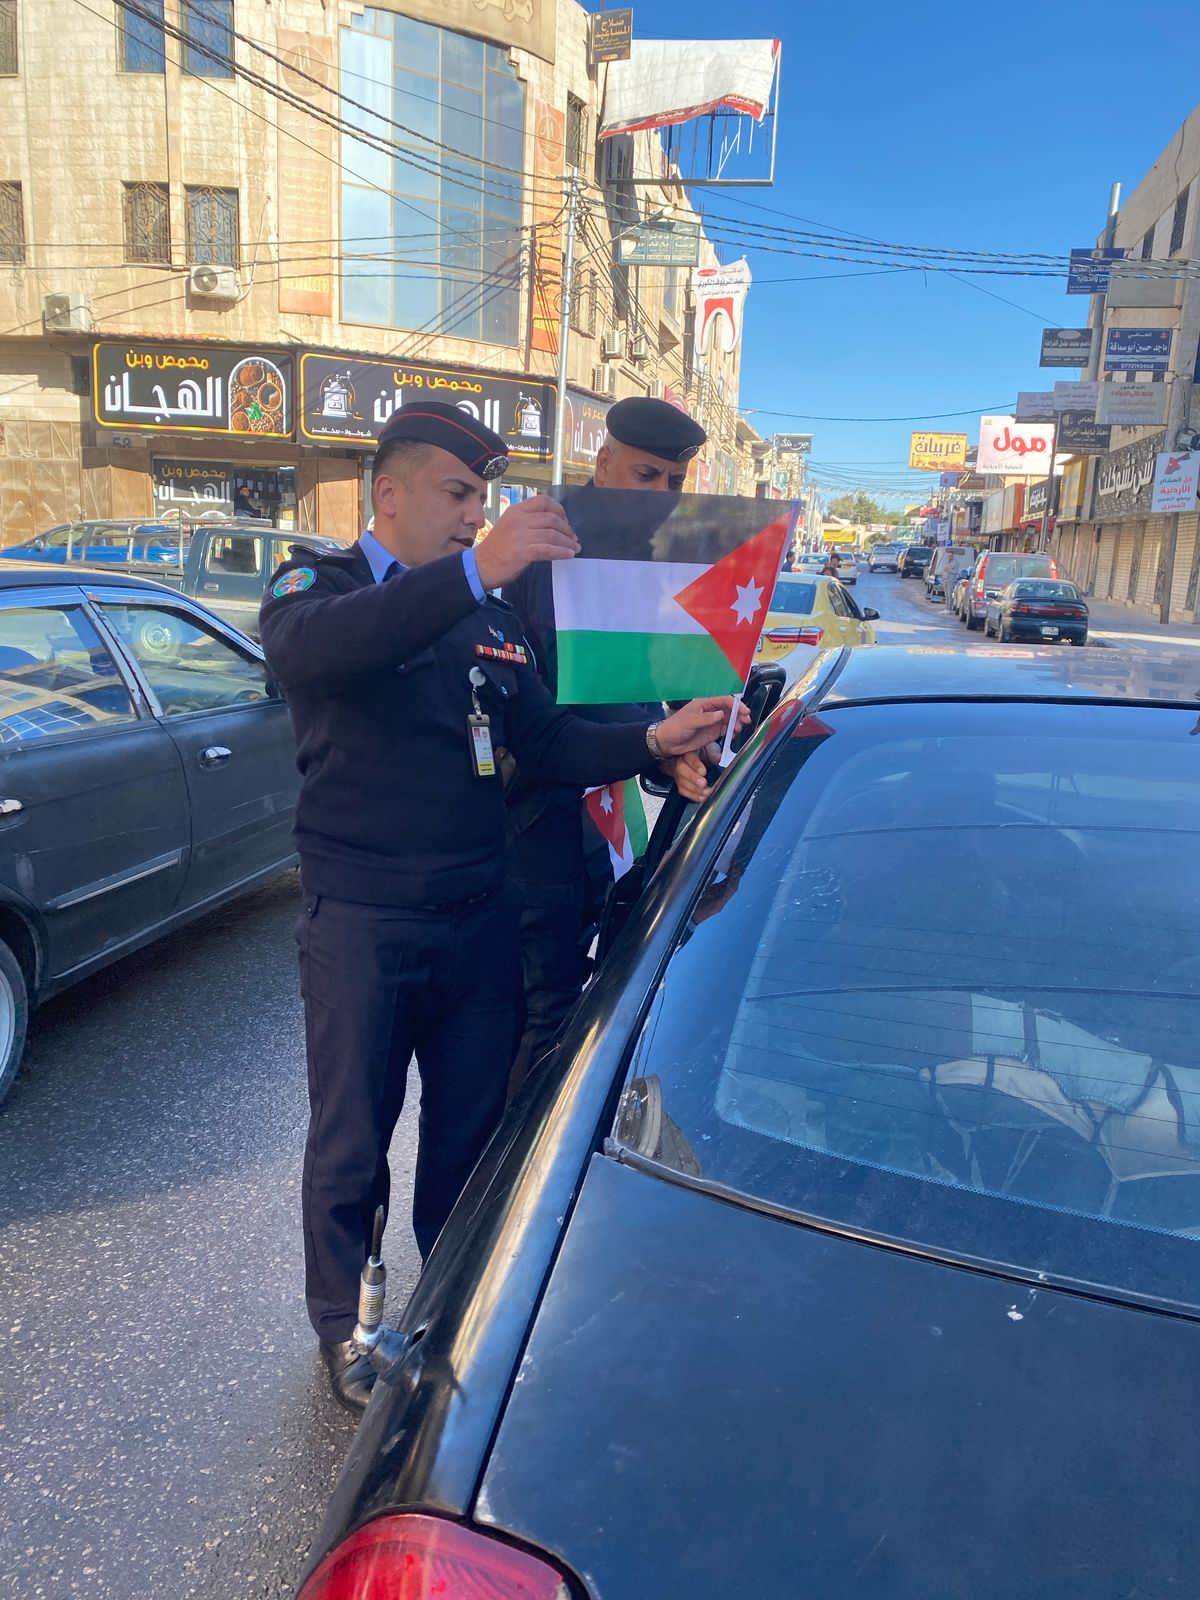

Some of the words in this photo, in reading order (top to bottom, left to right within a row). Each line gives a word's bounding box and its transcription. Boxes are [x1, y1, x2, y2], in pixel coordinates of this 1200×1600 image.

[125, 350, 153, 369] وبن
[156, 355, 209, 370] محمص
[393, 369, 423, 389] وبن
[426, 373, 484, 394] محمص
[104, 371, 222, 423] الهجان
[993, 426, 1046, 456] مول
[161, 465, 183, 477] وبن
[184, 467, 226, 479] محمص
[158, 479, 231, 506] الهجان
